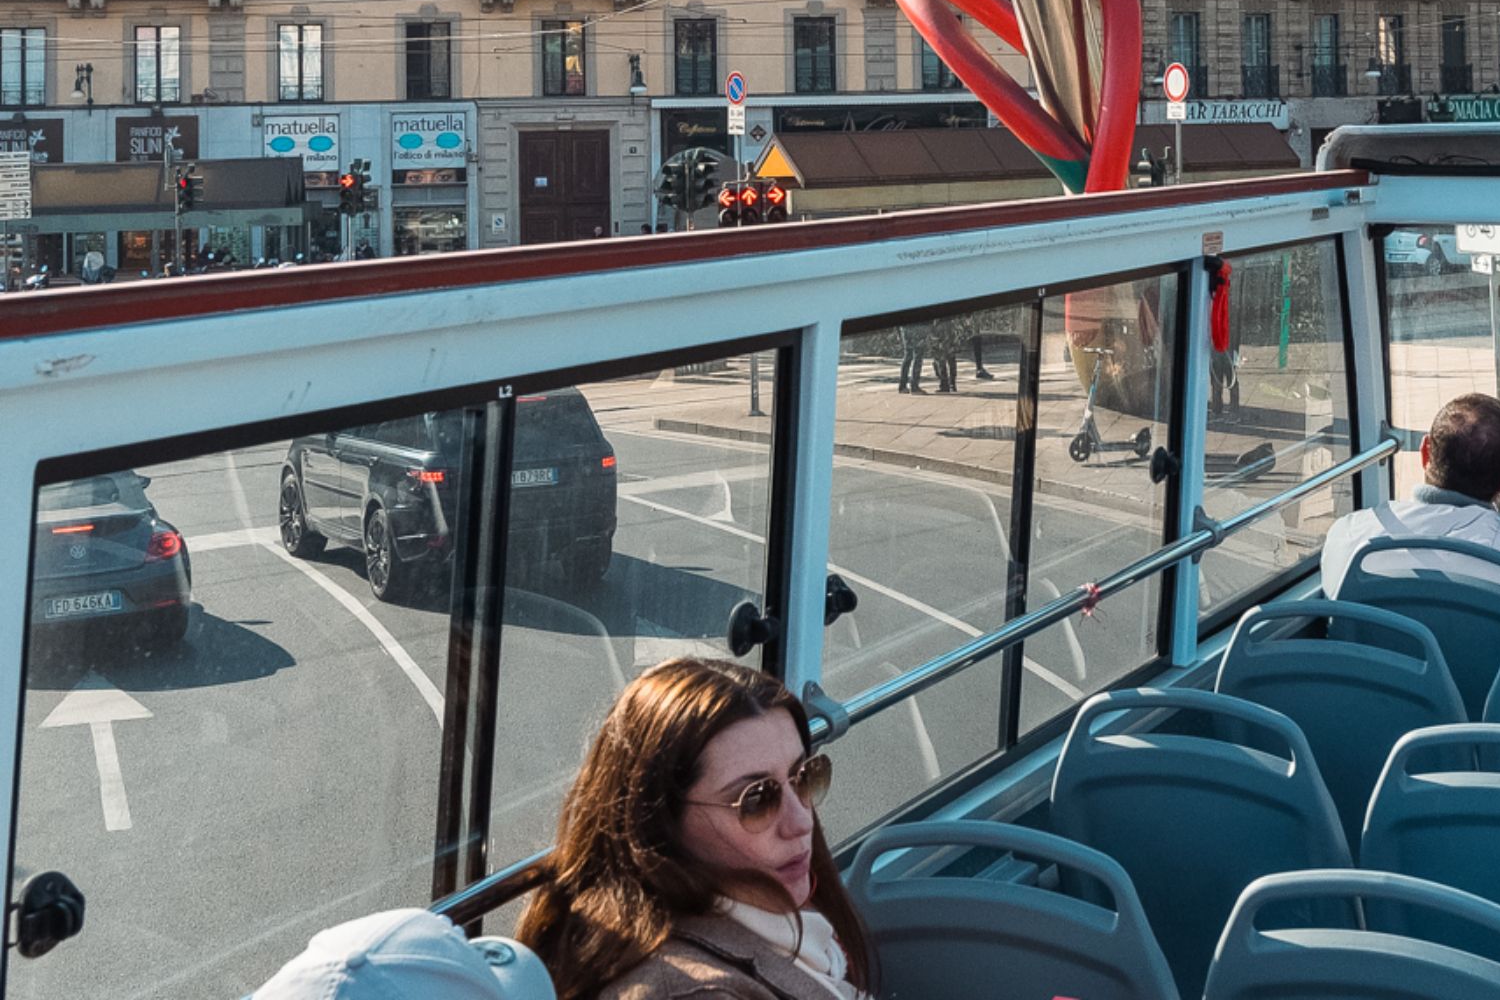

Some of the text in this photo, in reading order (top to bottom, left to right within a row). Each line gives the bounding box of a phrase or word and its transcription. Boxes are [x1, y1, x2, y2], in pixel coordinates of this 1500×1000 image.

[1186, 104, 1208, 119] AR
[1212, 103, 1282, 119] TABACCHI
[1428, 100, 1492, 119] MACIA
[265, 118, 336, 135] matuella
[394, 115, 464, 132] matuella
[498, 384, 513, 398] L2
